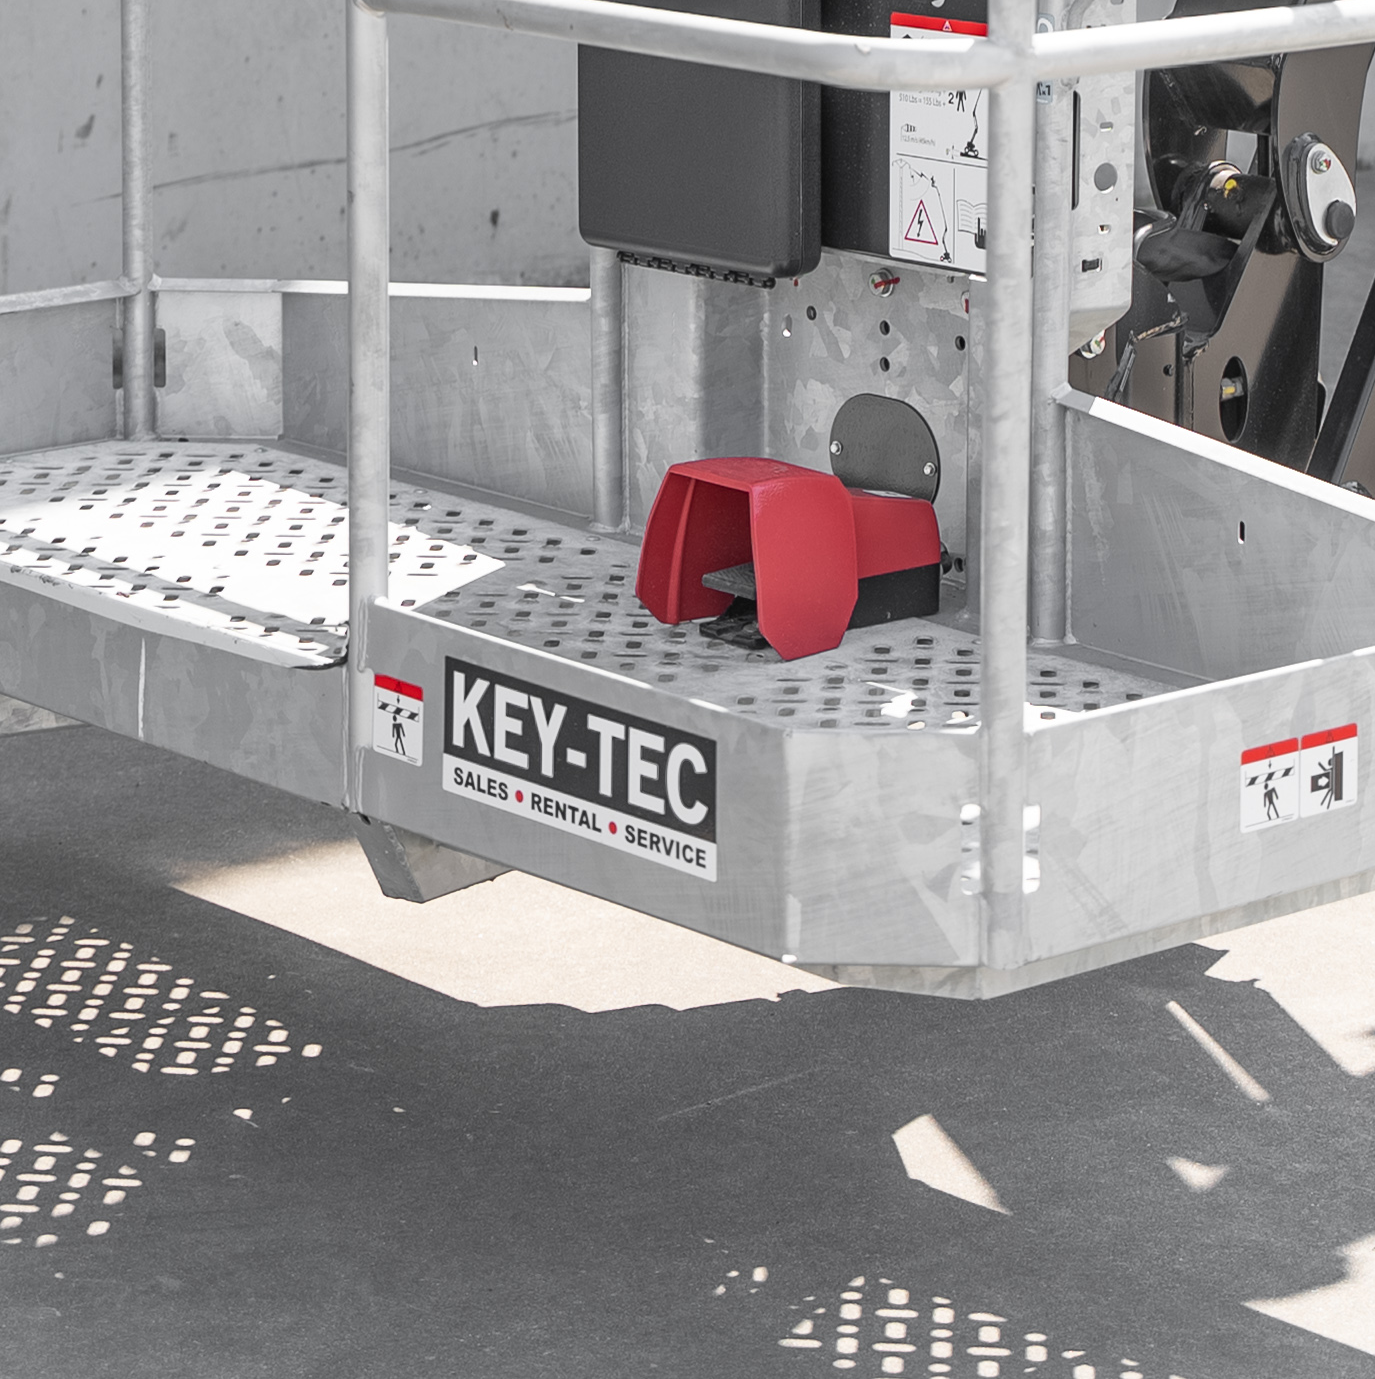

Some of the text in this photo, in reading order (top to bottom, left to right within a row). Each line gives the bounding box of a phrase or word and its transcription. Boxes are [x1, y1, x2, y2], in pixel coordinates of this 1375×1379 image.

[452, 670, 709, 826] KEY-TEC
[453, 766, 707, 869] SALES RENTAL SERVICE
